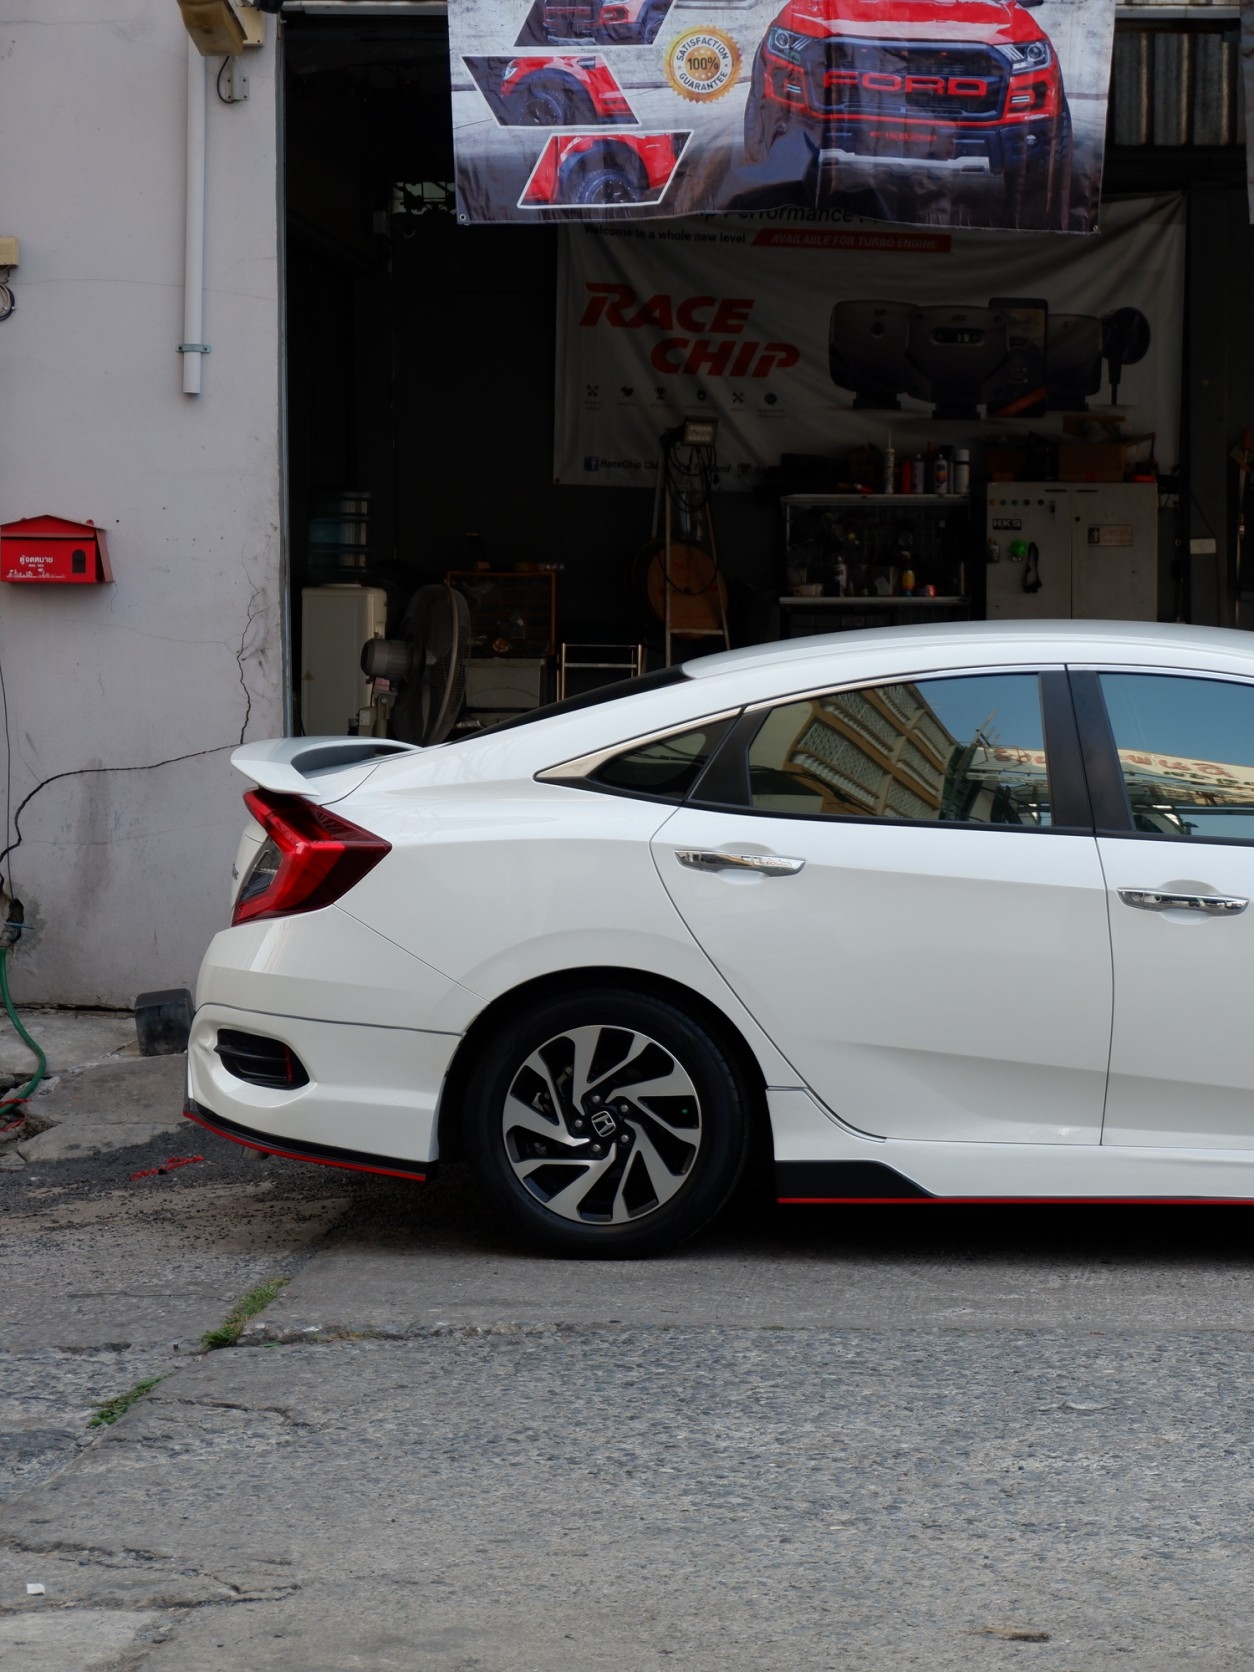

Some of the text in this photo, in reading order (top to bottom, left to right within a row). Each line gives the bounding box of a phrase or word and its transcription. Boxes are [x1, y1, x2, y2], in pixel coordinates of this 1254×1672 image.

[676, 36, 729, 61] SATISFACTION
[687, 56, 719, 70] 100%
[679, 70, 728, 91] GUARANTEE
[823, 70, 989, 97] FORD
[584, 222, 746, 244] Welcome to a whole new level
[771, 233, 937, 249] AVAILABLE FOR TURBO ENGINE
[579, 281, 756, 334] RACE
[651, 337, 800, 378] CHIP
[600, 458, 642, 471] RaceChip
[993, 519, 1021, 529] HKS
[19, 555, 53, 564] ตู้จดหมาย
